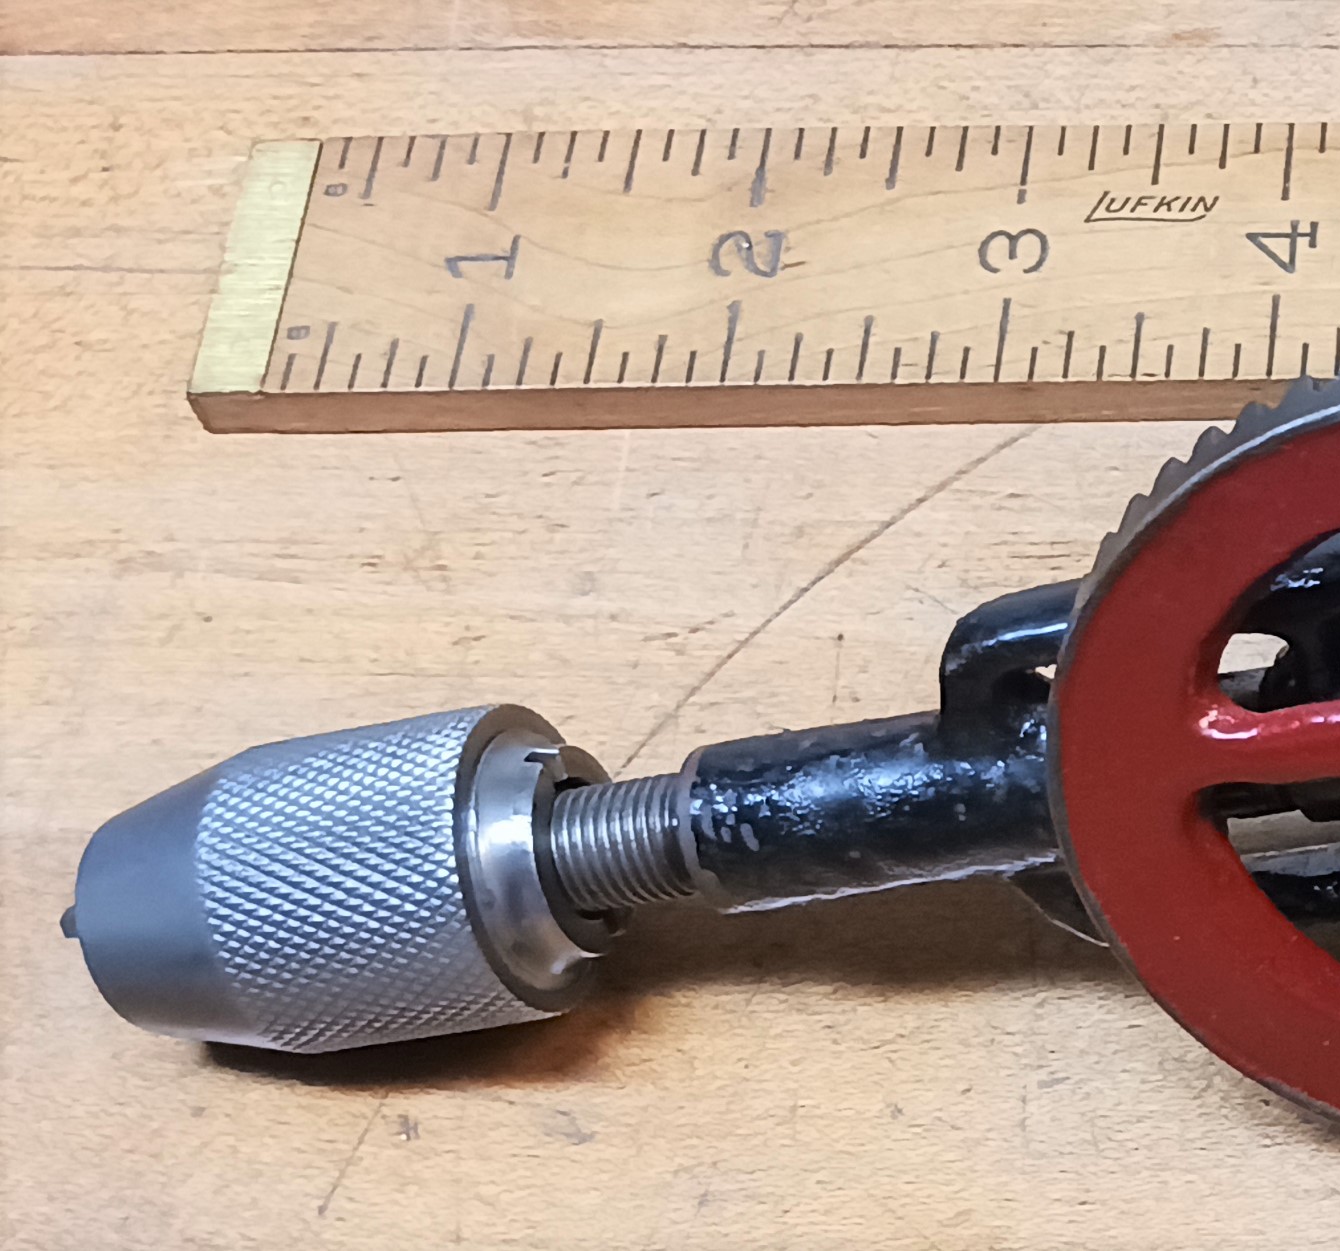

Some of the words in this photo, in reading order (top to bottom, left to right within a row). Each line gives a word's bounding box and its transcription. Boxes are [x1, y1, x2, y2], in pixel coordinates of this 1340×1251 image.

[1083, 190, 1220, 224] LUFKIN
[445, 234, 522, 281] 1
[707, 229, 786, 279] 2
[978, 227, 1051, 275] 3
[1245, 219, 1320, 274] 4
